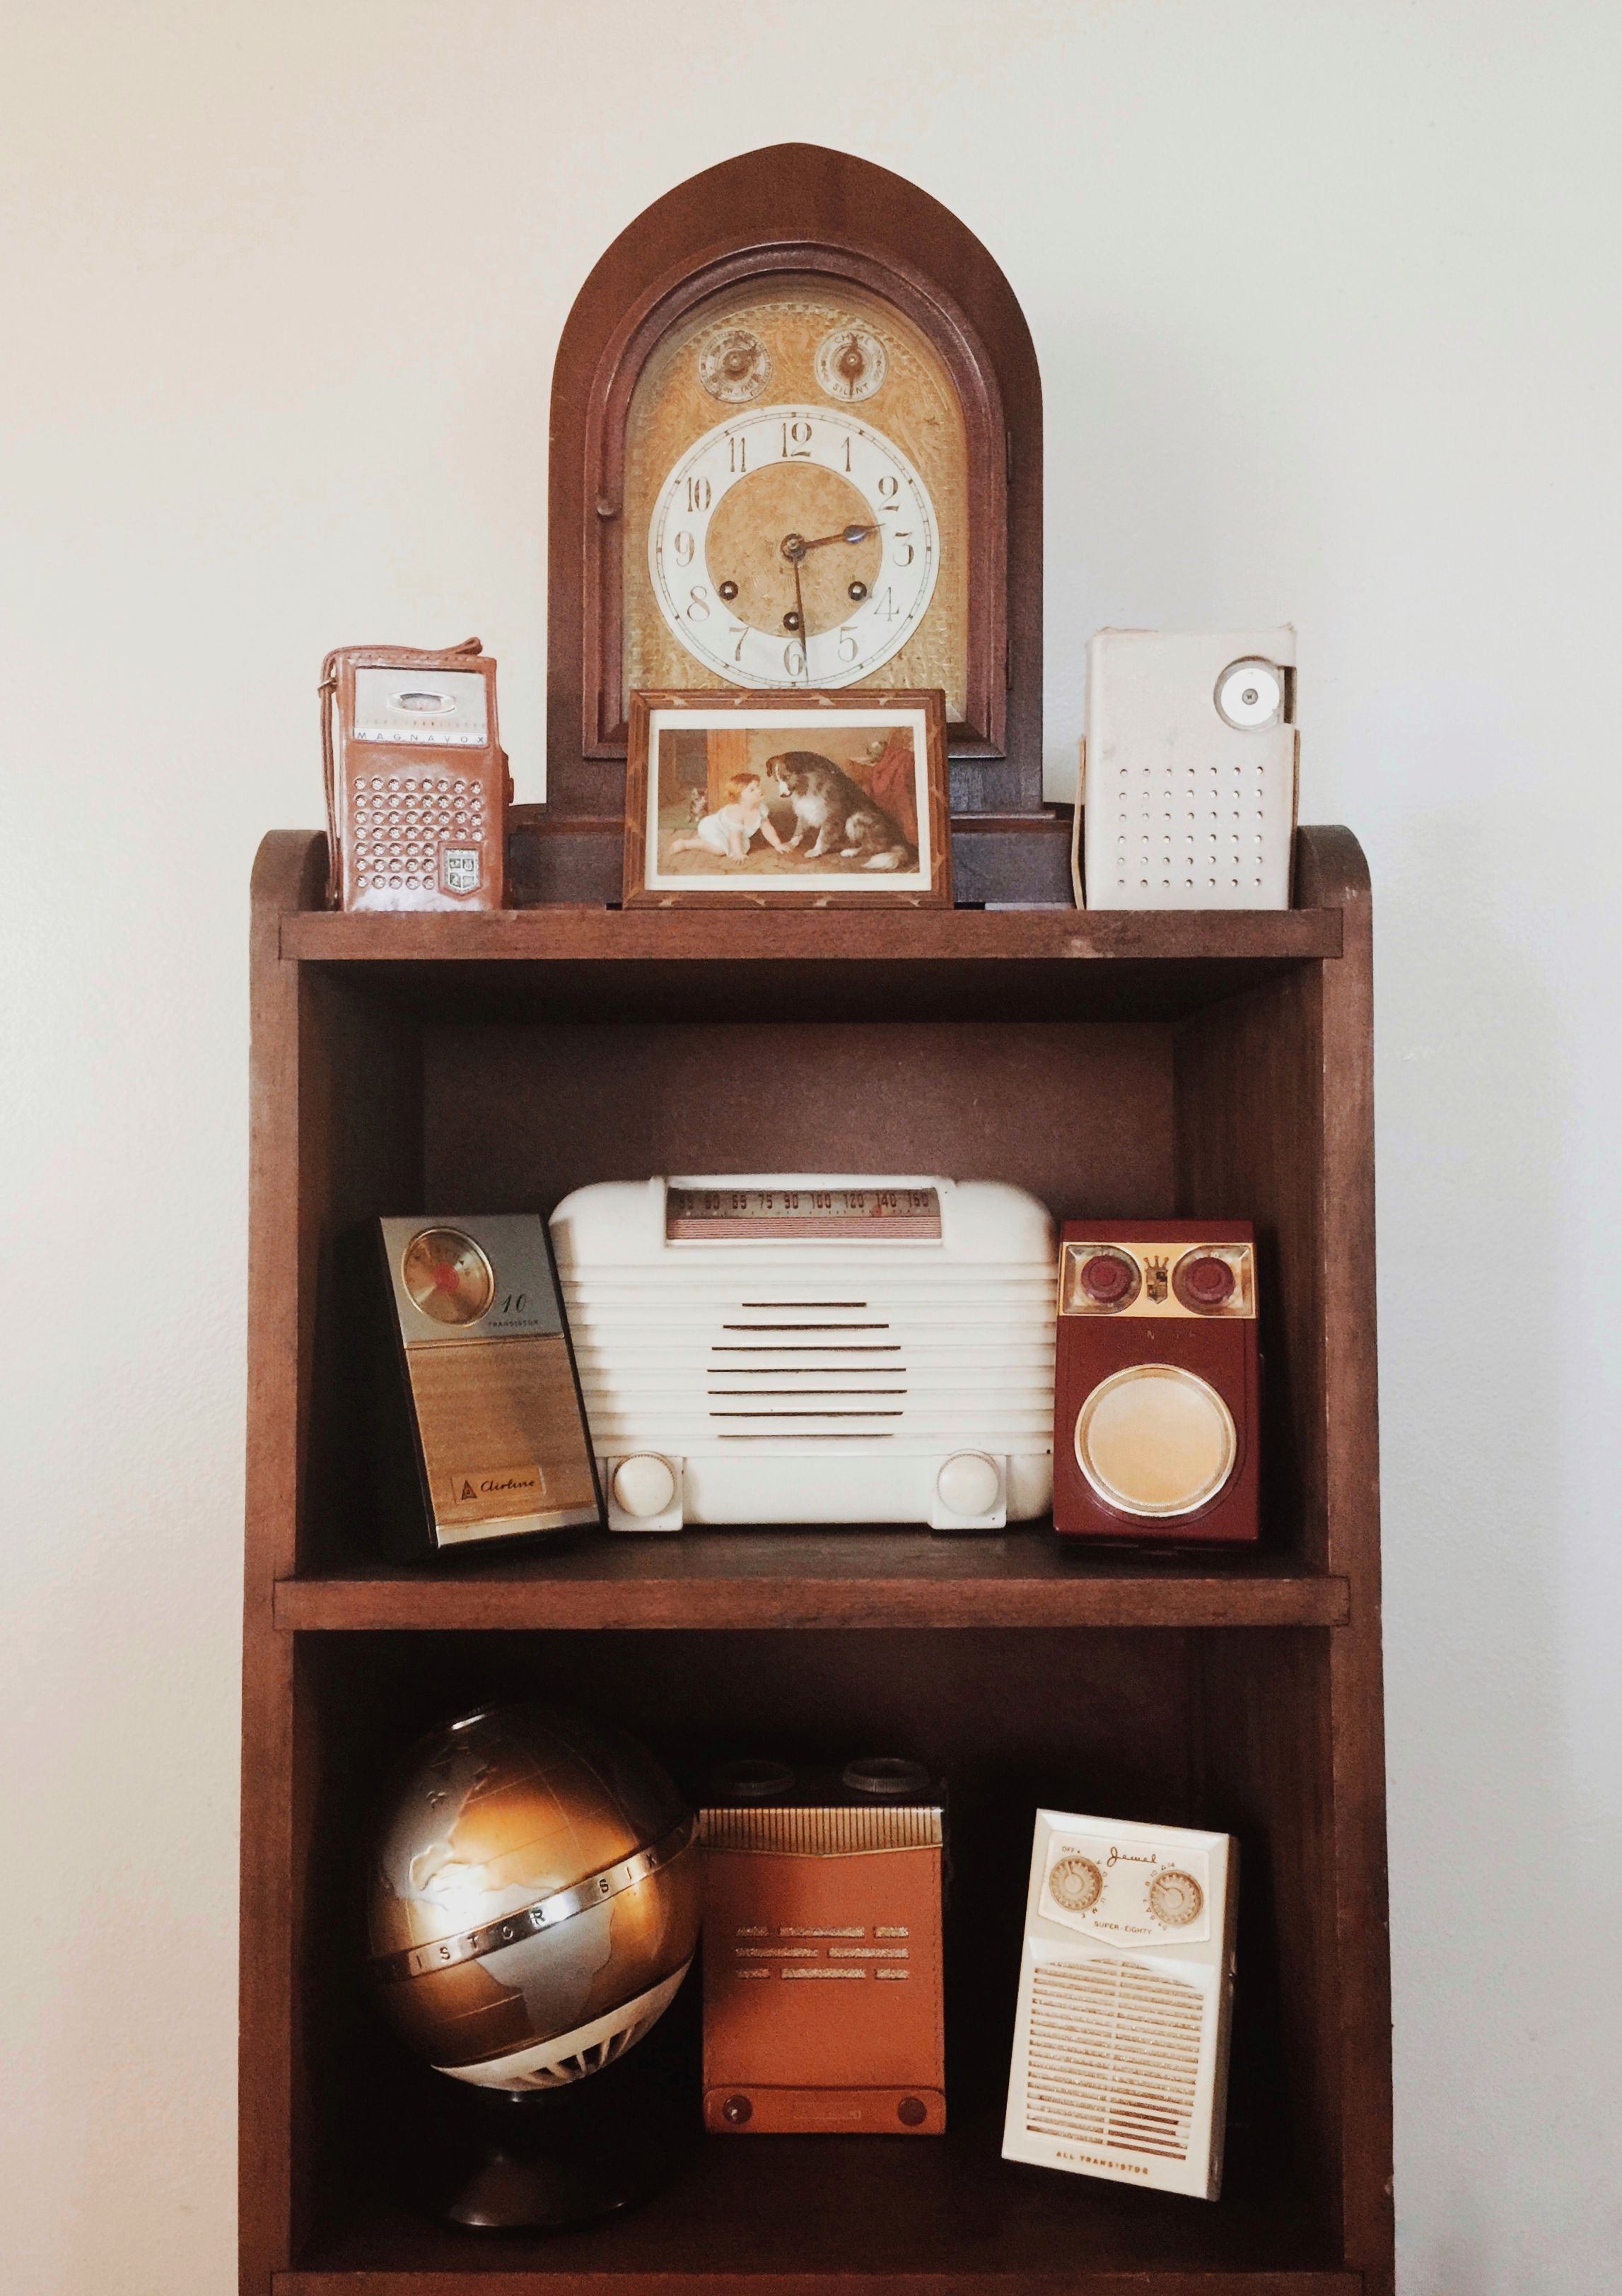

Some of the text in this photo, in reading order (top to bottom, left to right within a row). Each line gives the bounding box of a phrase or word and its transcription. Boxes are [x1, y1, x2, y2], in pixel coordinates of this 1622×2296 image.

[834, 333, 870, 346] CHME
[832, 382, 870, 396] SILNT
[729, 436, 747, 473] 11
[781, 422, 813, 458] 12
[841, 436, 852, 472] 1
[687, 476, 712, 512] 10
[878, 476, 899, 512] 2
[674, 530, 695, 567] 9
[892, 532, 915, 567] 3
[686, 585, 711, 622] 8
[873, 586, 900, 622] 4
[728, 626, 751, 662] 7
[783, 640, 805, 676] 6
[837, 626, 858, 662] 5
[356, 732, 484, 744] MAGNAVOX
[757, 1193, 774, 1210] 75
[810, 1192, 832, 1210] 100
[844, 1192, 865, 1210] 120
[875, 1191, 897, 1209] 140
[498, 1293, 527, 1313] 10
[488, 1318, 539, 1328] TRANSISTOR
[597, 1853, 658, 1894] SIX
[1106, 1846, 1157, 1868] Jewel
[1056, 2150, 1149, 2175] ALL TRANSISTOR
